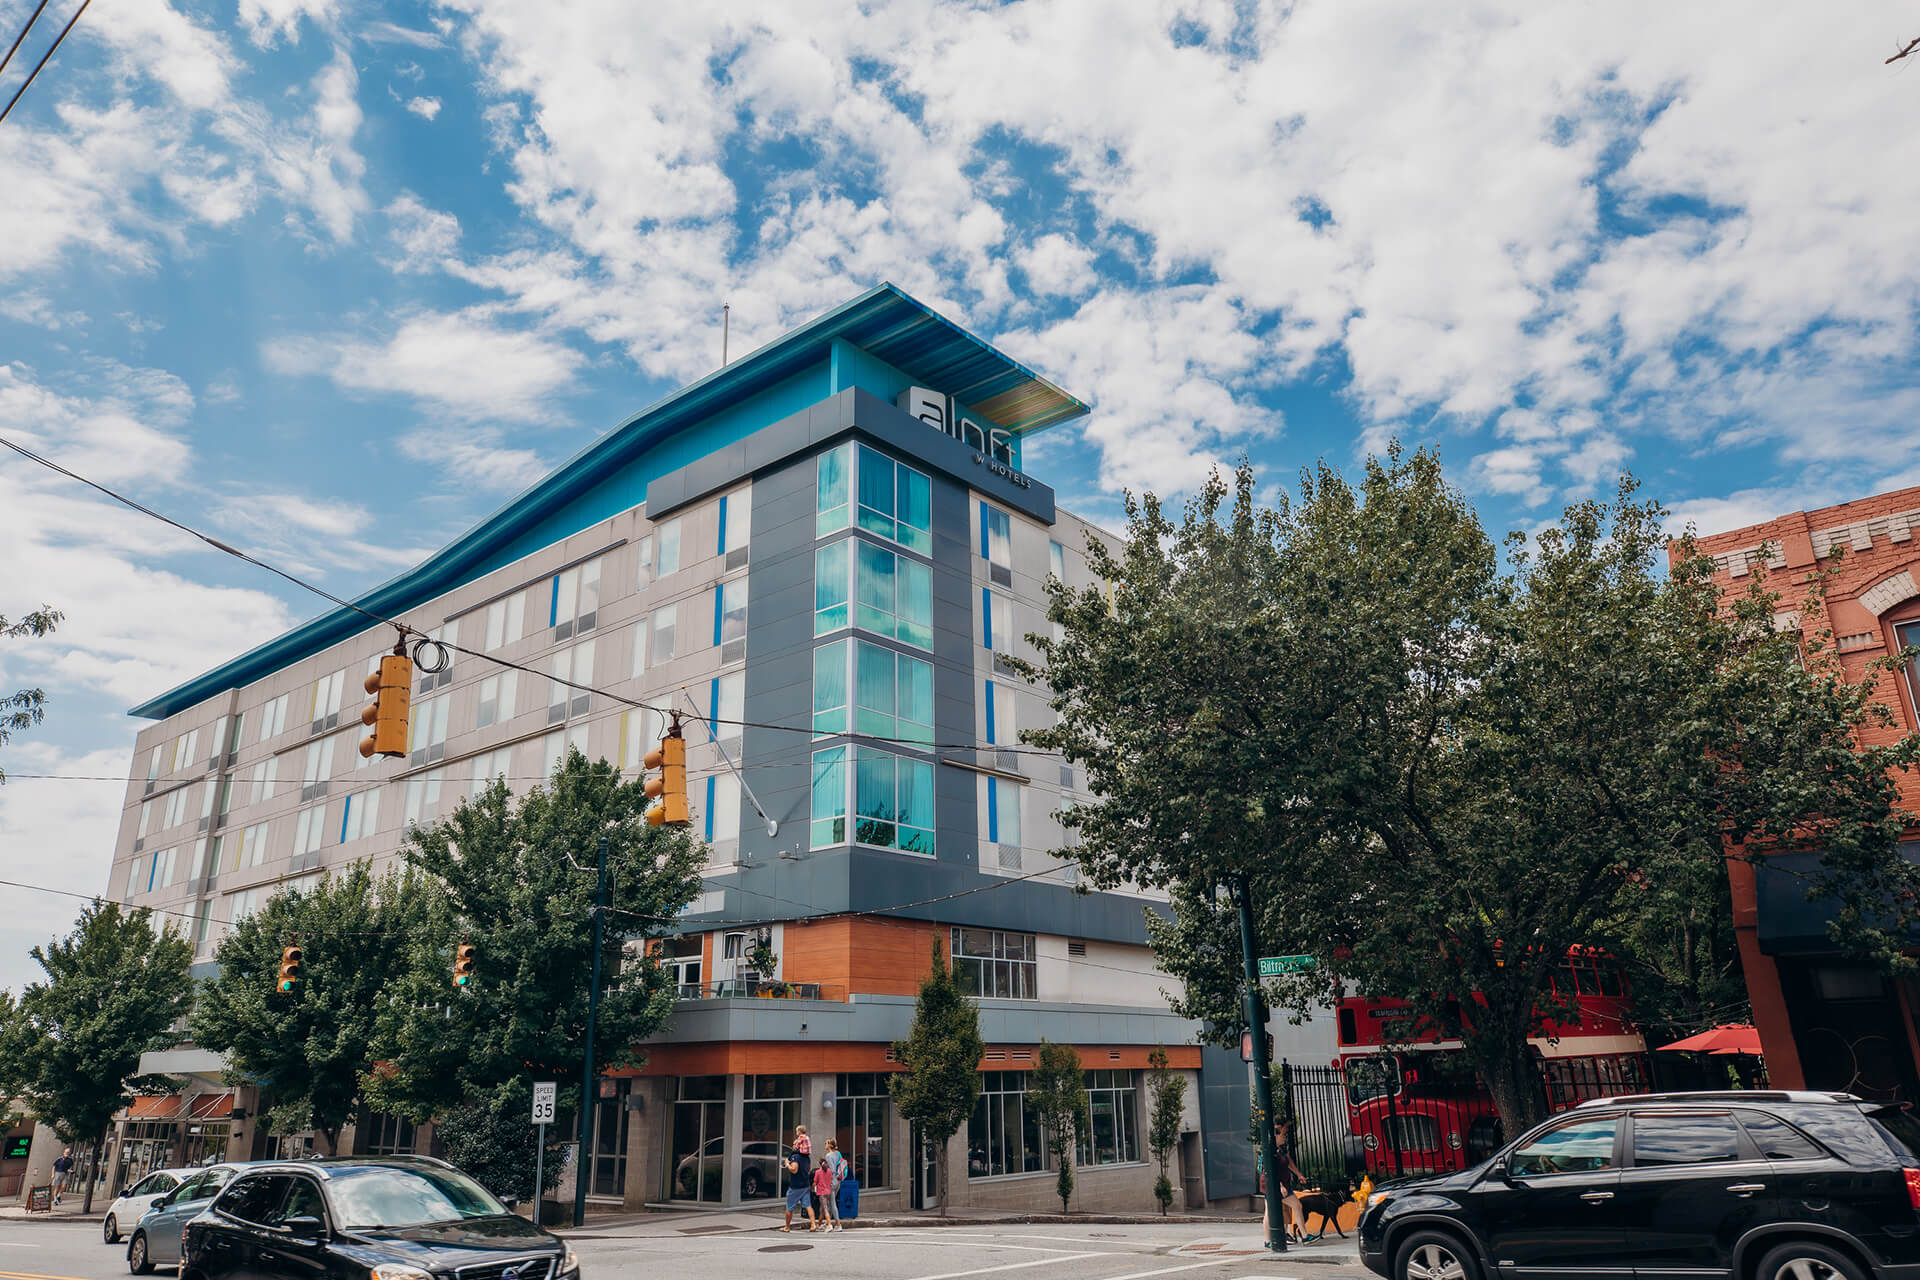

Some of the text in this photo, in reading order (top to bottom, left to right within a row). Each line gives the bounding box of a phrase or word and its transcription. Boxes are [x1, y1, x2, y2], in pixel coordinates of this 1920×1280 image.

[975, 453, 1032, 489] W HOTELS
[535, 1103, 553, 1118] 35
